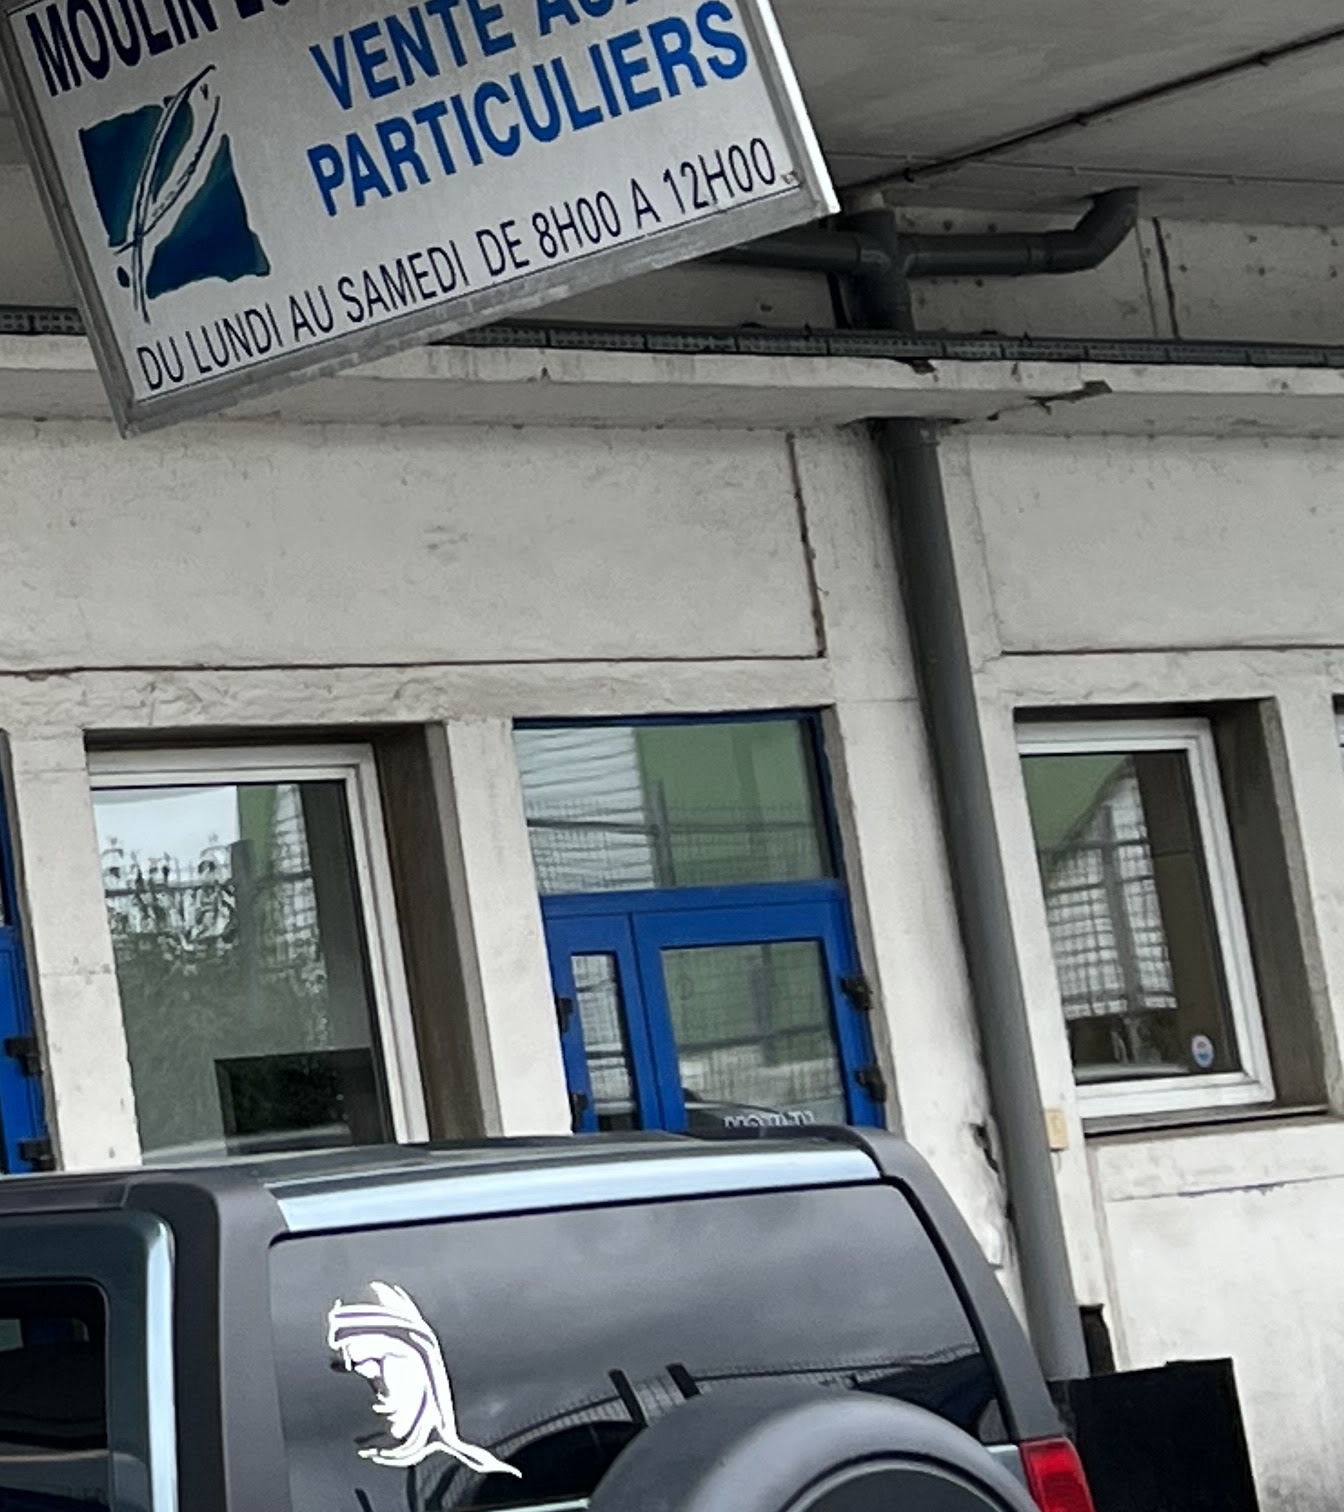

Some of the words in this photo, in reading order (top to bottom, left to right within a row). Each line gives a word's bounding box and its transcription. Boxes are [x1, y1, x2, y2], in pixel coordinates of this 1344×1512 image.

[306, 0, 748, 217] PARTICULIERS
[136, 336, 185, 392] DU
[185, 303, 284, 374] LUNDI
[288, 285, 334, 343] AU
[337, 239, 470, 324] SAMEDI
[475, 219, 530, 277] DE
[531, 190, 621, 259] 8H00
[630, 178, 661, 229] A
[663, 137, 776, 214] 12H00
